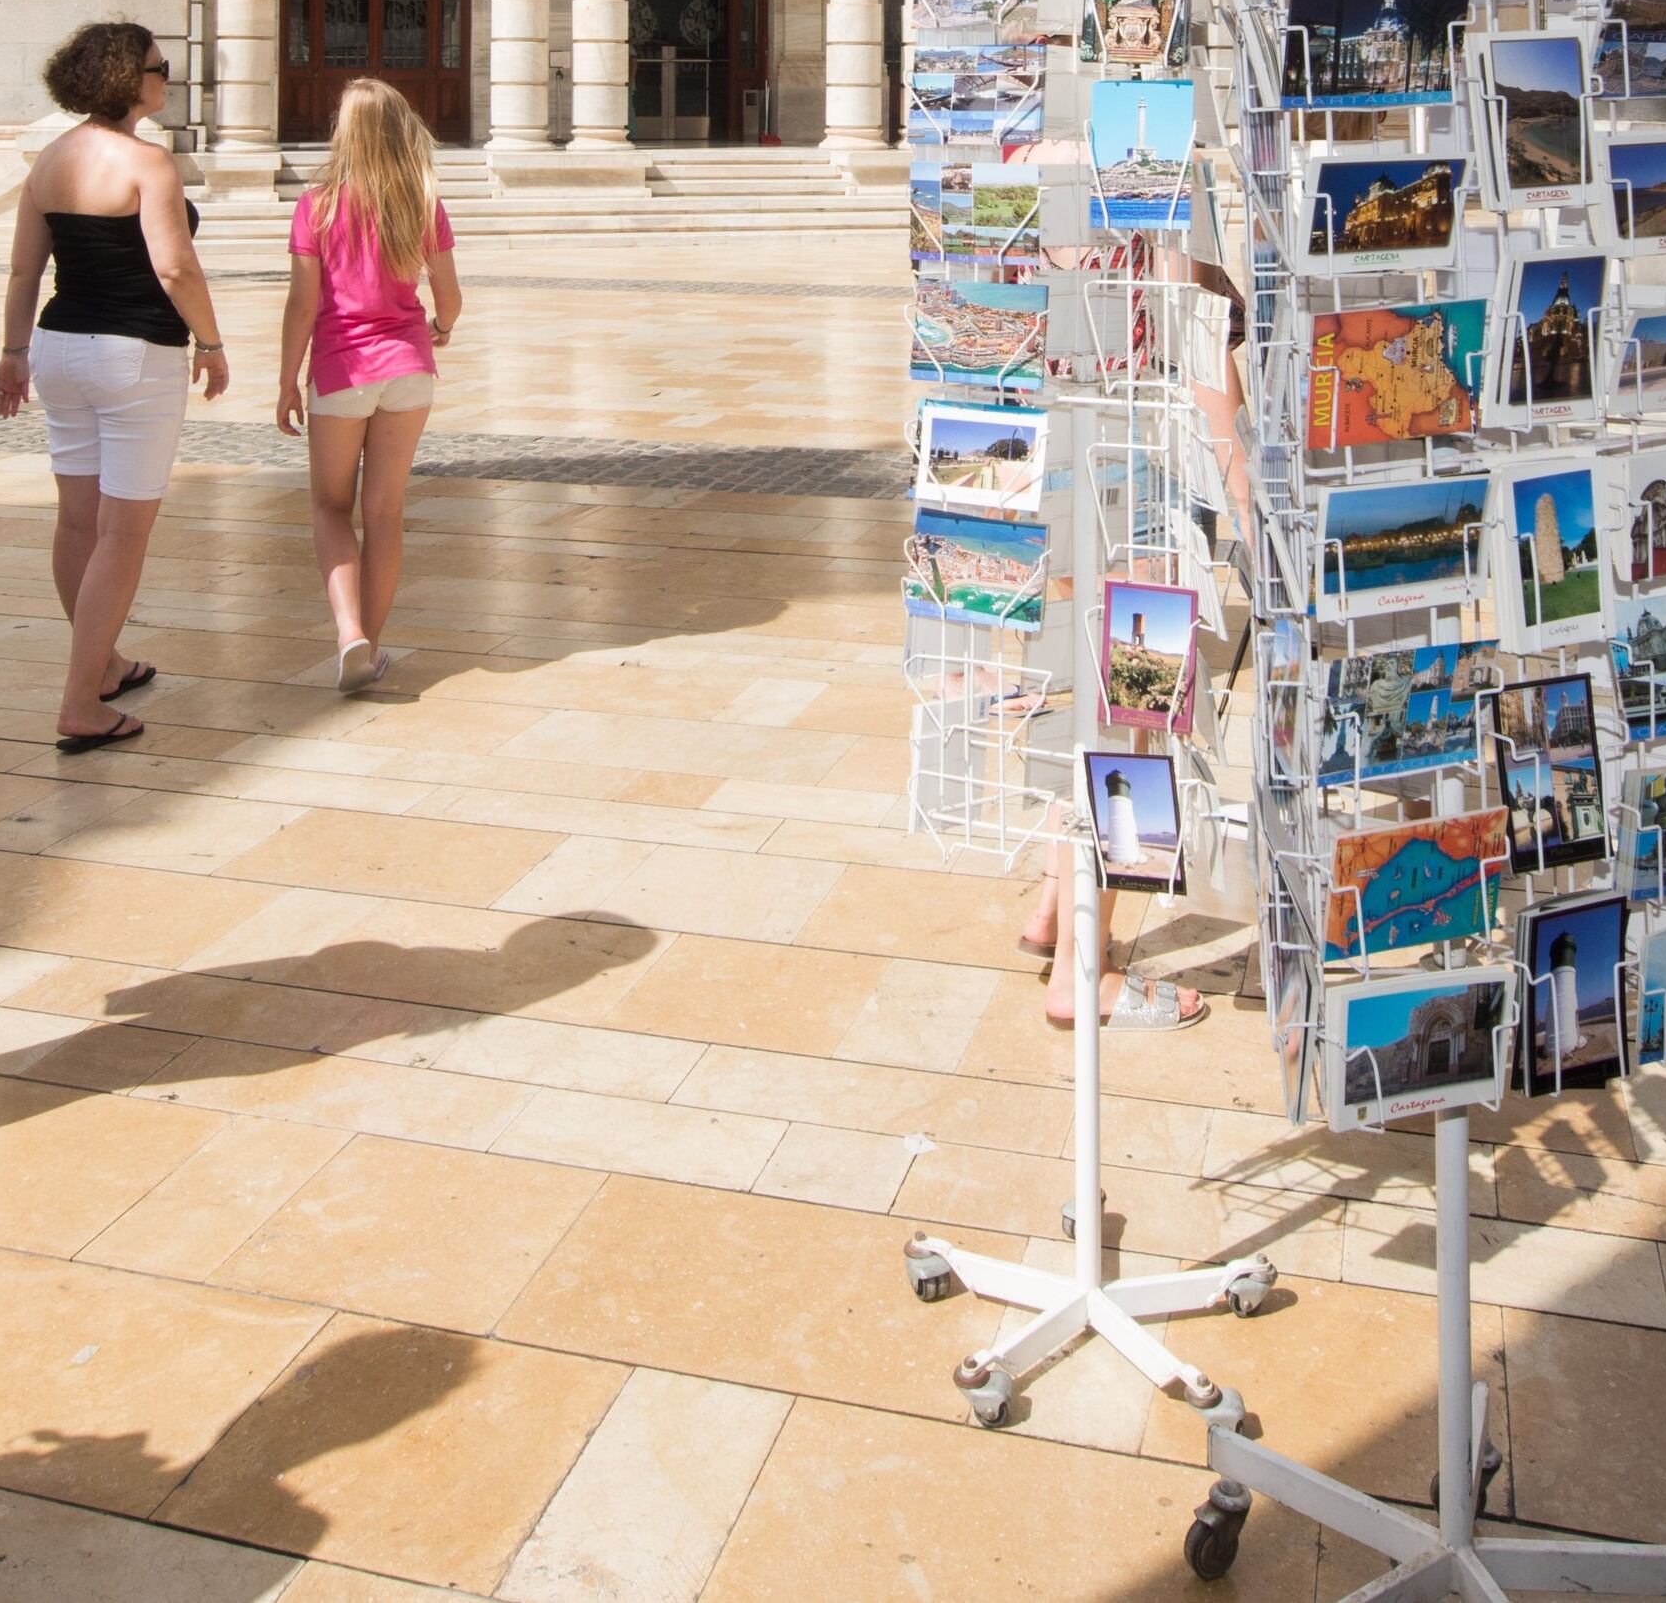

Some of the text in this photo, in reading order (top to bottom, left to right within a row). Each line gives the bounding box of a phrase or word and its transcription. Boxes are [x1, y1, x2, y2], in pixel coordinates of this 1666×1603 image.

[1291, 92, 1450, 107] CARTAGENA
[1526, 190, 1569, 199] CARTAGENA
[1353, 253, 1400, 262] CARTAGENA
[1411, 337, 1419, 368] MURCIA
[1314, 332, 1335, 426] MURCIA
[1532, 406, 1572, 415] ARTAGENA
[1378, 594, 1425, 606] Cartagena
[1390, 1097, 1446, 1113] Cartagena
